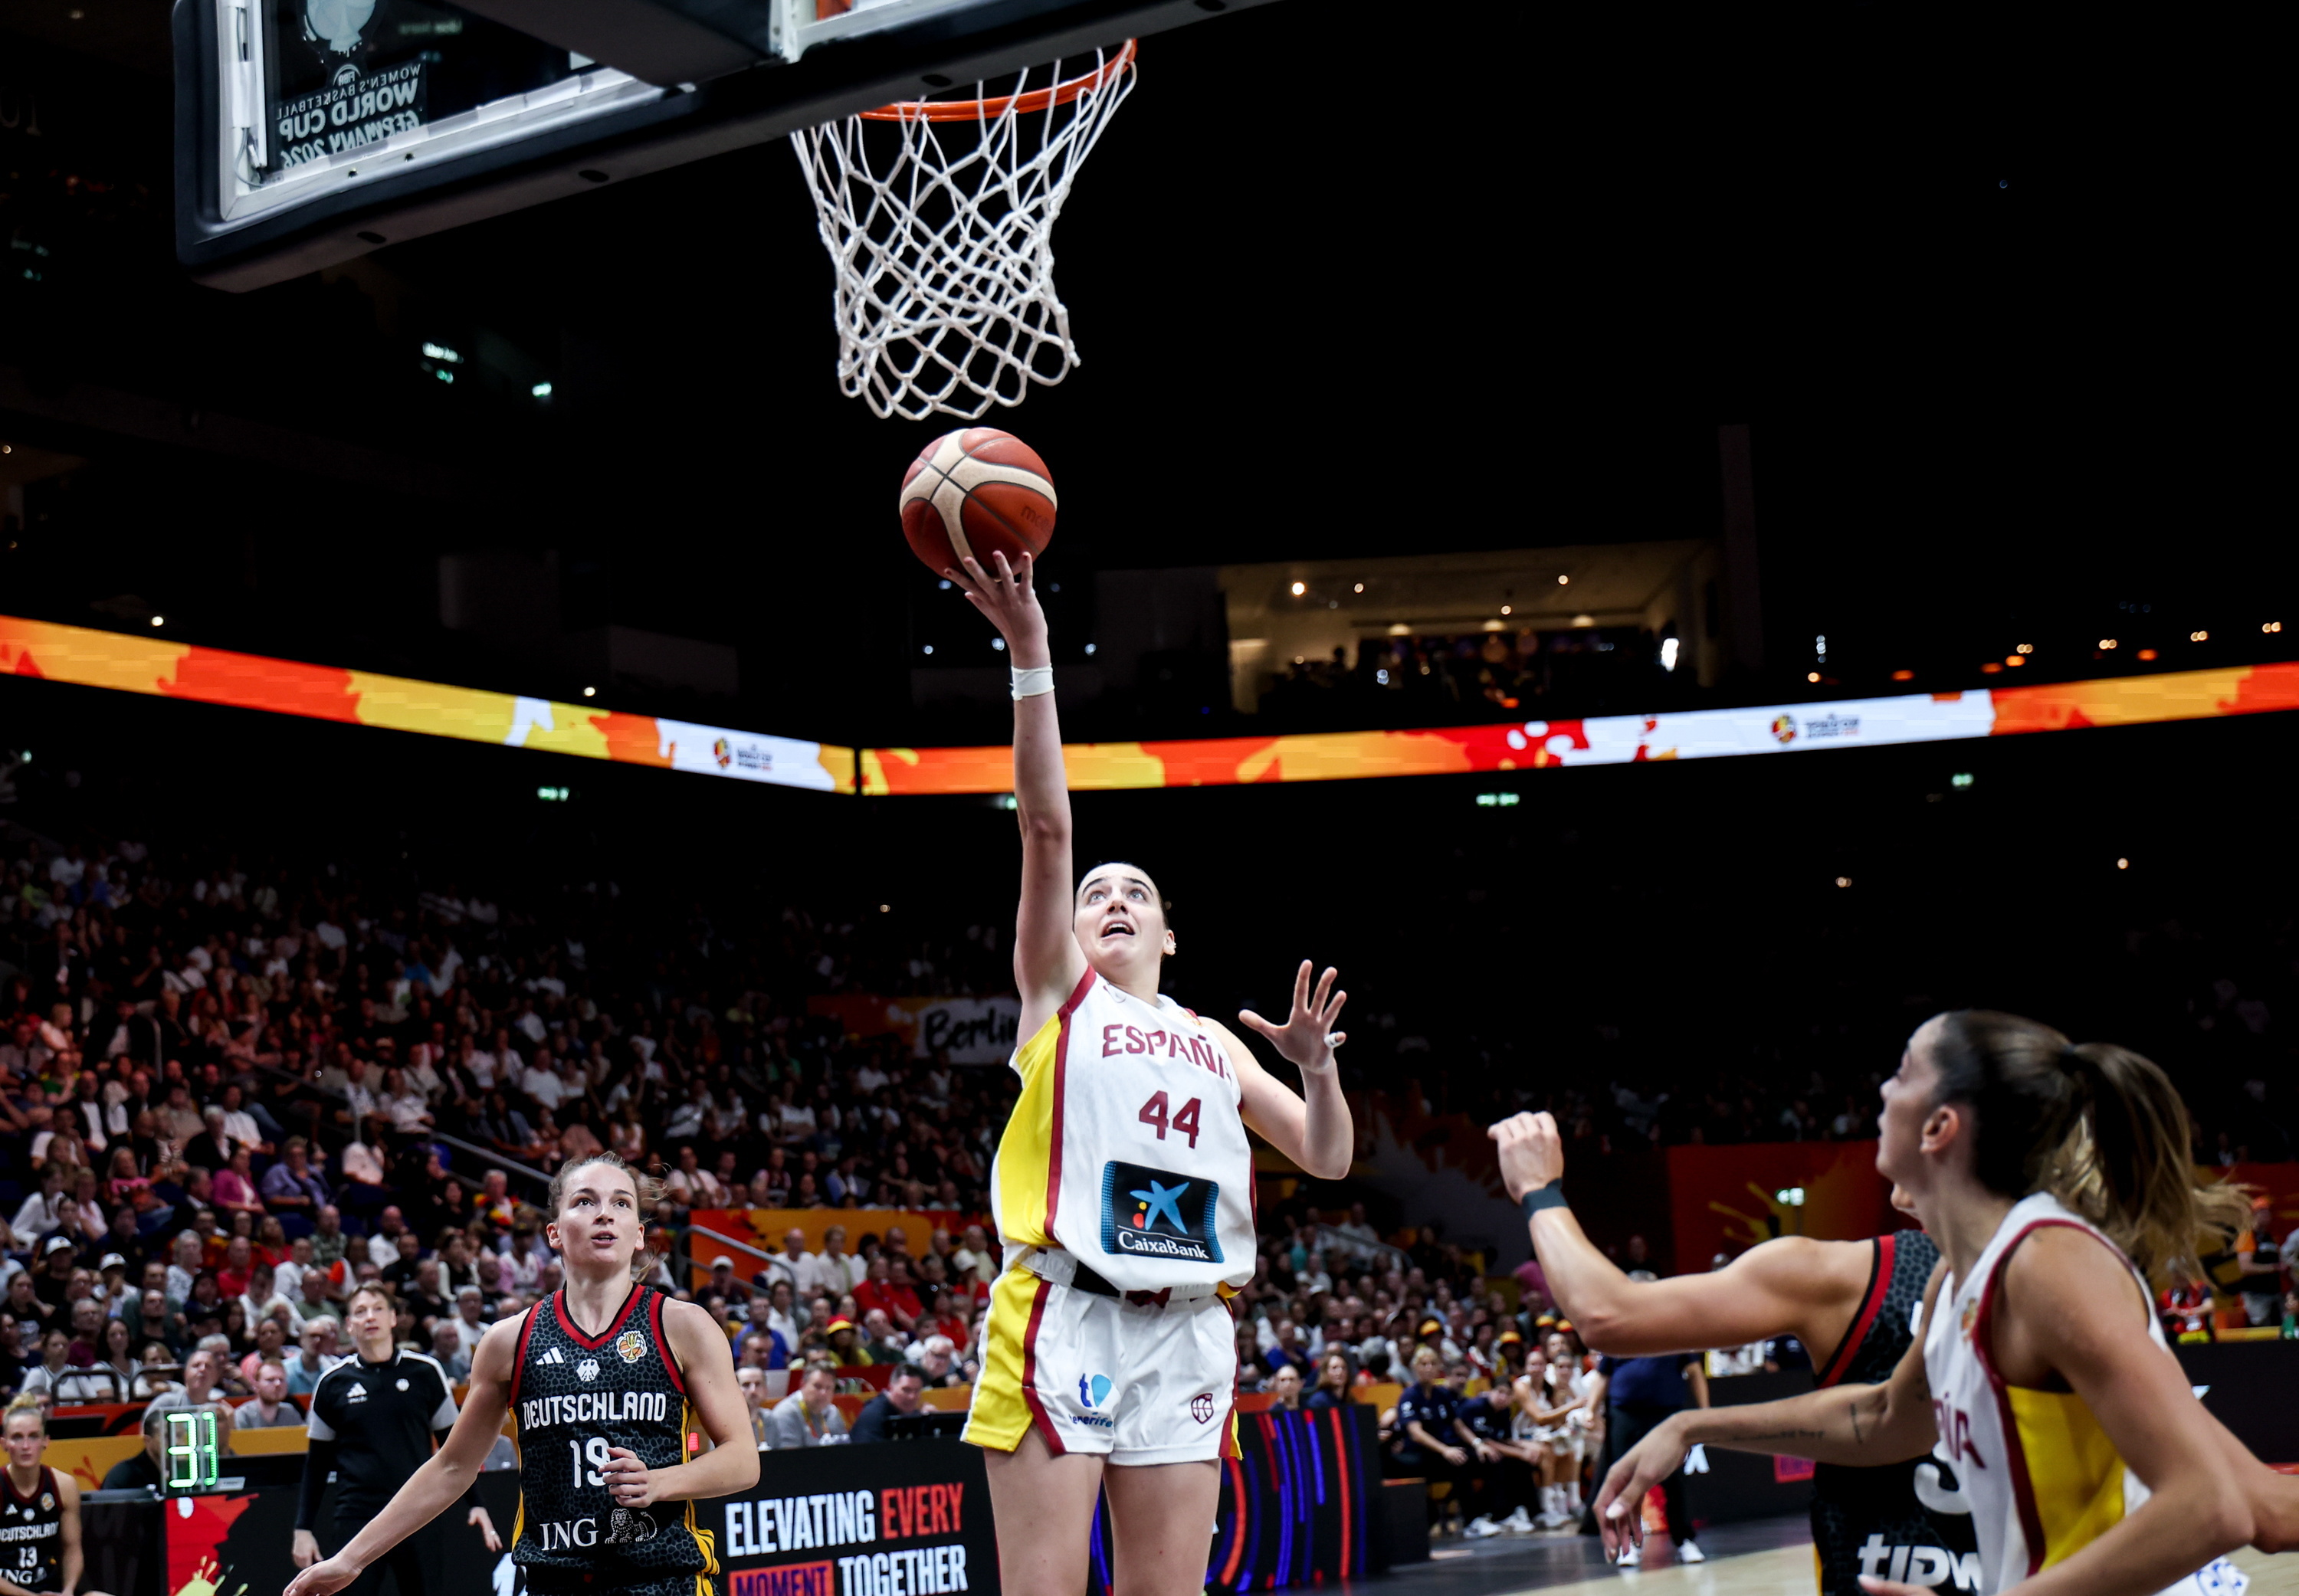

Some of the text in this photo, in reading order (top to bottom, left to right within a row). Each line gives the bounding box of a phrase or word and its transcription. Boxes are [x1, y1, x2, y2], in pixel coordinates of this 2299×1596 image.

[1139, 1090, 1202, 1149] 44
[1118, 1231, 1210, 1259] CaixaBank
[523, 1391, 667, 1431] DEUTSCHLAND
[540, 1518, 599, 1551] ING
[725, 1482, 965, 1558] ELEVATING EVERY
[18, 1546, 38, 1568] 13
[838, 1543, 969, 1596] TOGETHER
